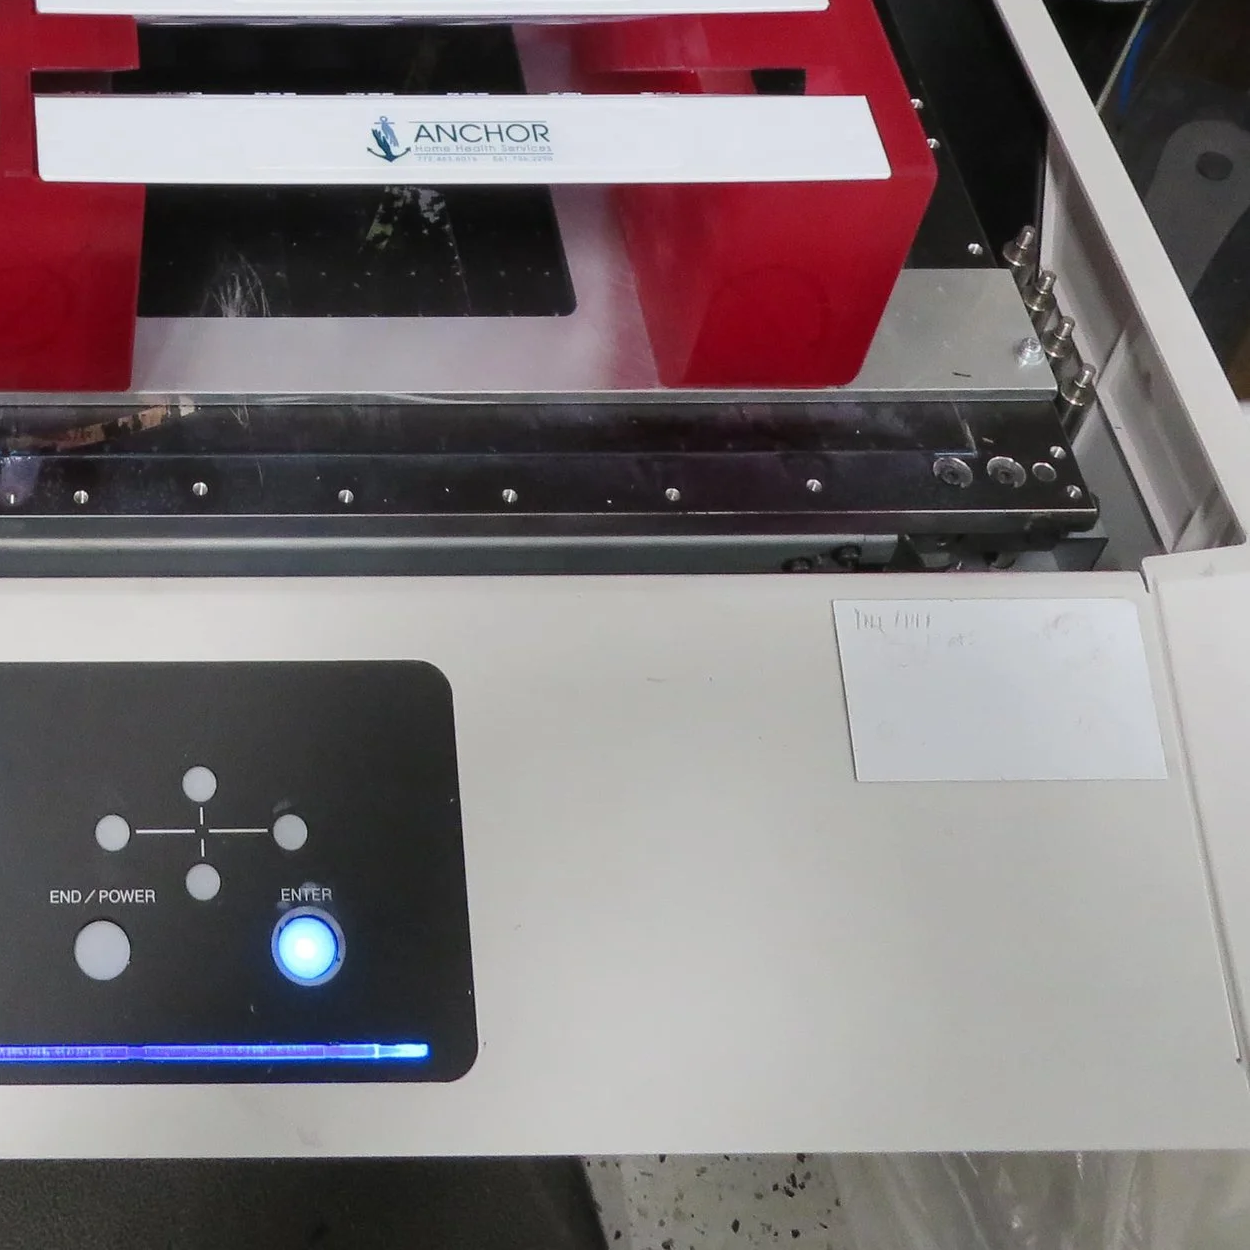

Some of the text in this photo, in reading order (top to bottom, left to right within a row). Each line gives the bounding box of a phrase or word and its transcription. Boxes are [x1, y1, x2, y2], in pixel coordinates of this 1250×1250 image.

[414, 123, 550, 143] ANCHOR
[415, 144, 552, 153] Home Health Services
[281, 888, 333, 902] ENTER
